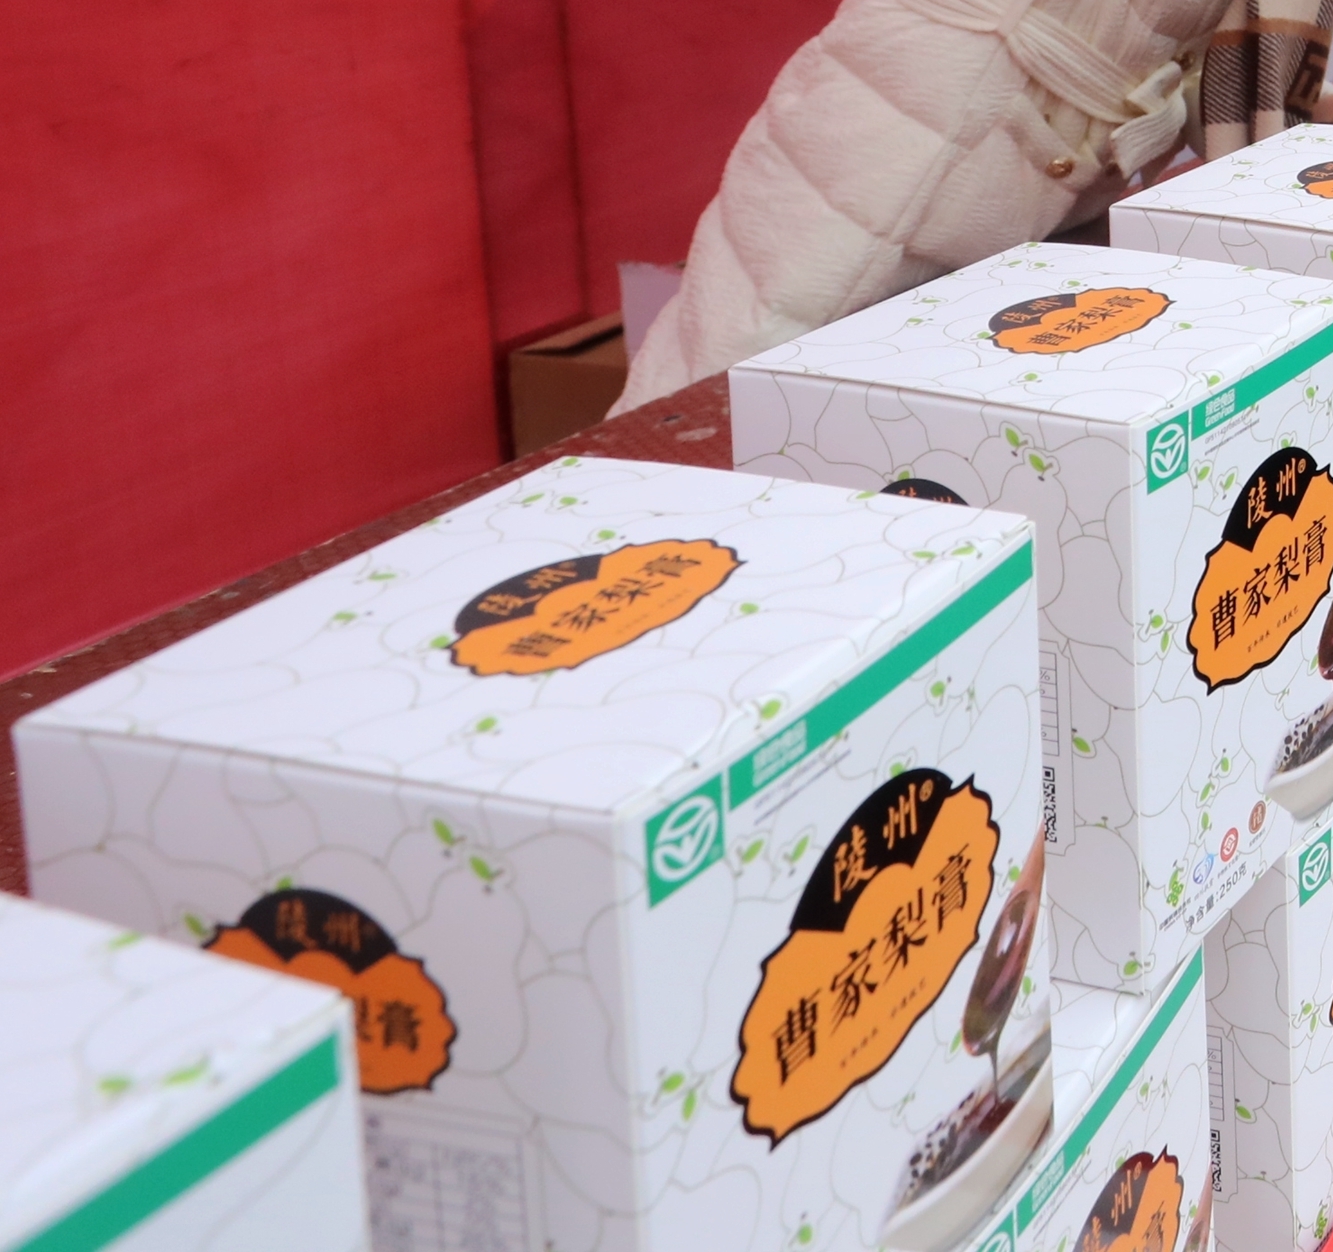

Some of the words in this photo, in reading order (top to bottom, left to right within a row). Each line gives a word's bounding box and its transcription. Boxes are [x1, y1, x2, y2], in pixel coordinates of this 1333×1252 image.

[1027, 294, 1145, 347] 曹家梨膏
[1247, 457, 1297, 529] 陵州
[503, 552, 702, 658] 曹家梨膏
[1210, 515, 1329, 652] 曹家梨膏
[833, 783, 919, 904] 陵州
[1186, 861, 1249, 933] 净含量:250克
[771, 843, 972, 1087] 曹家梨膏
